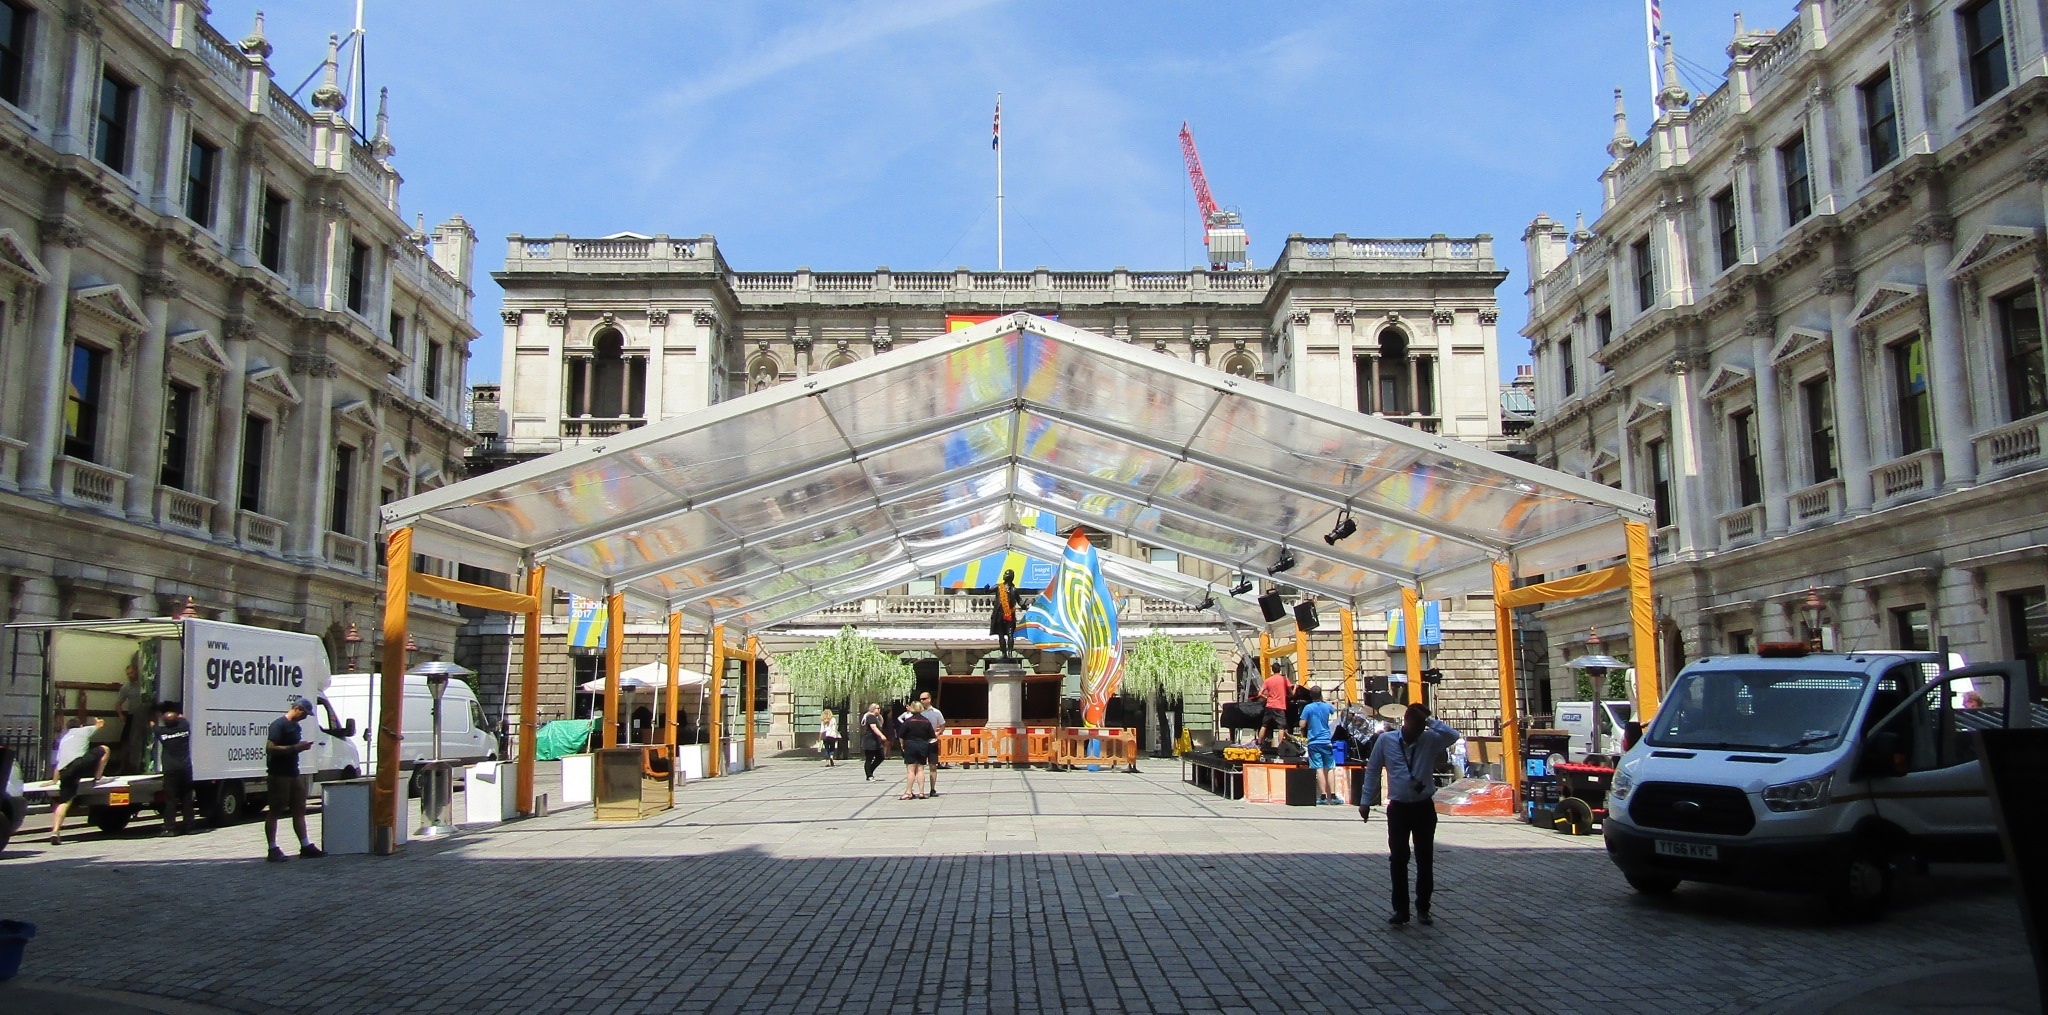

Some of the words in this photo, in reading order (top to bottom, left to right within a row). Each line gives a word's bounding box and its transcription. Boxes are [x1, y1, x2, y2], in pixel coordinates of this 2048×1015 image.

[572, 609, 592, 618] 2017
[207, 640, 230, 651] www.
[206, 655, 303, 690] greathire
[206, 722, 246, 736] Fabulous
[249, 722, 270, 736] Furni
[228, 747, 266, 761] 020-8965-
[1659, 841, 1688, 855] YT66
[1690, 844, 1713, 857] KVC
